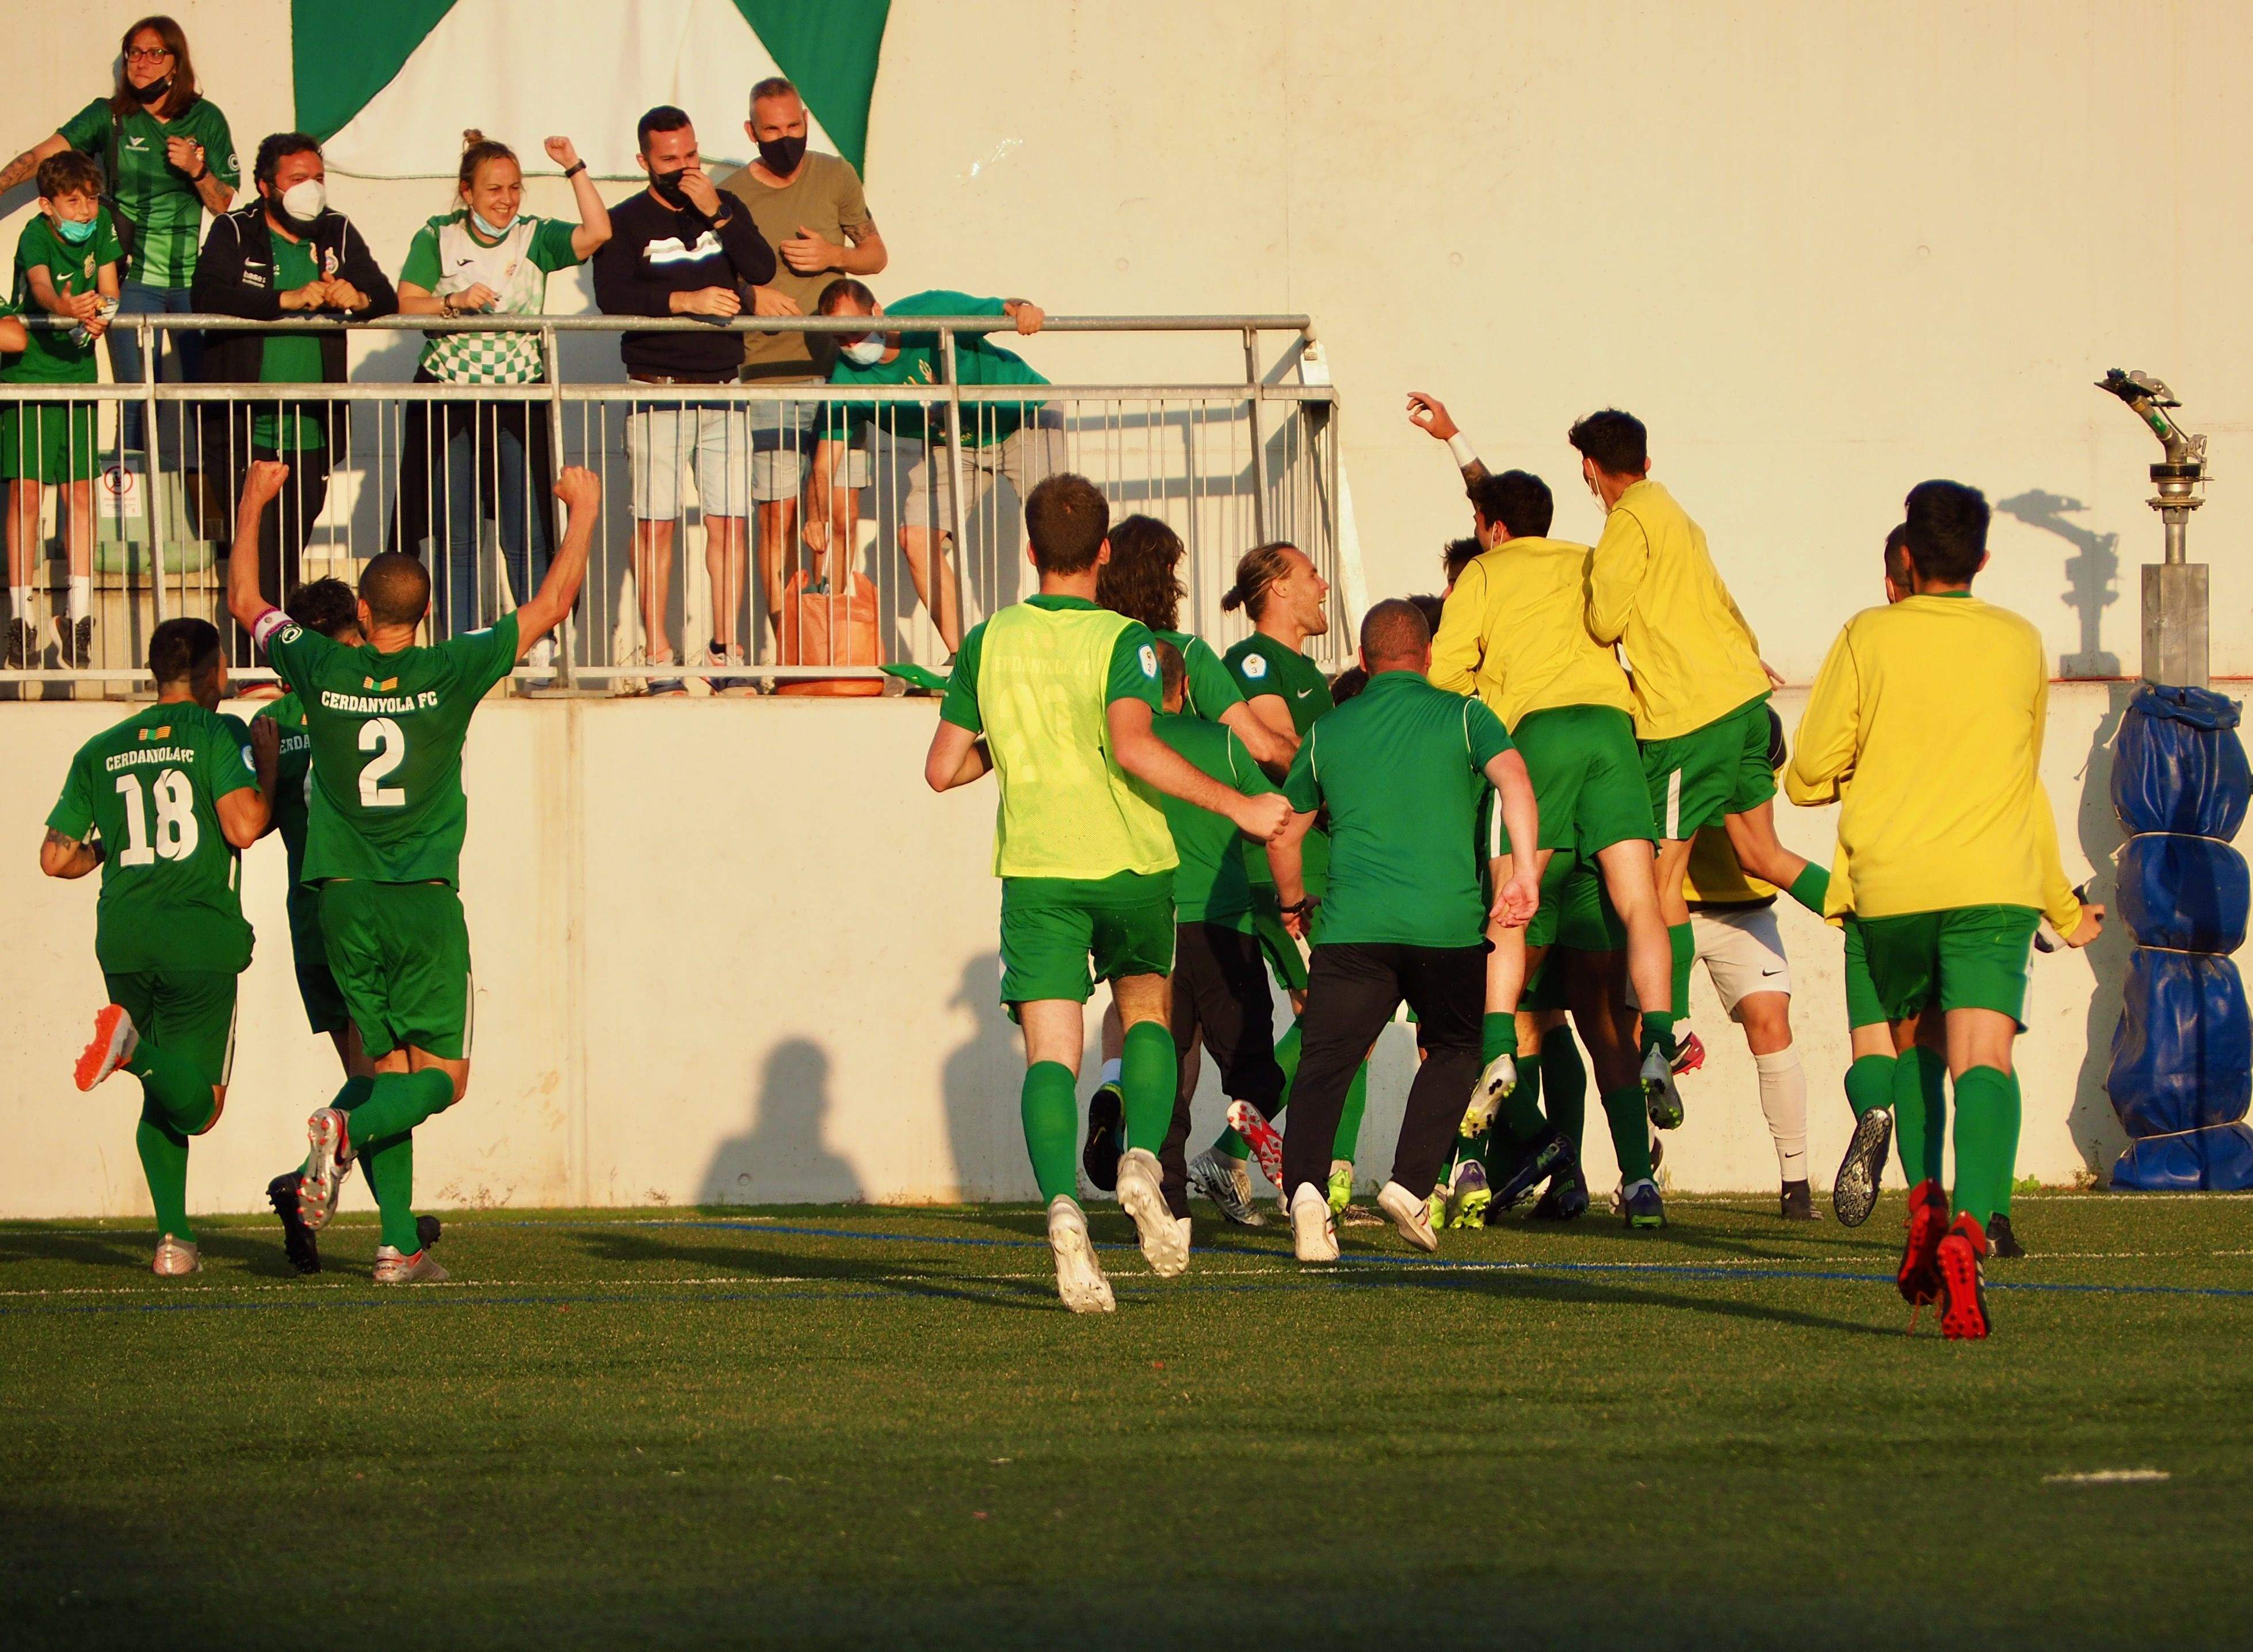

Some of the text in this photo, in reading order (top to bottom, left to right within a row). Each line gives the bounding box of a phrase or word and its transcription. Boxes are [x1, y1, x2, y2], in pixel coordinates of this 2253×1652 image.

[321, 691, 438, 713] CERDANYOLA FC
[358, 717, 406, 808] 2
[115, 768, 198, 867] 18
